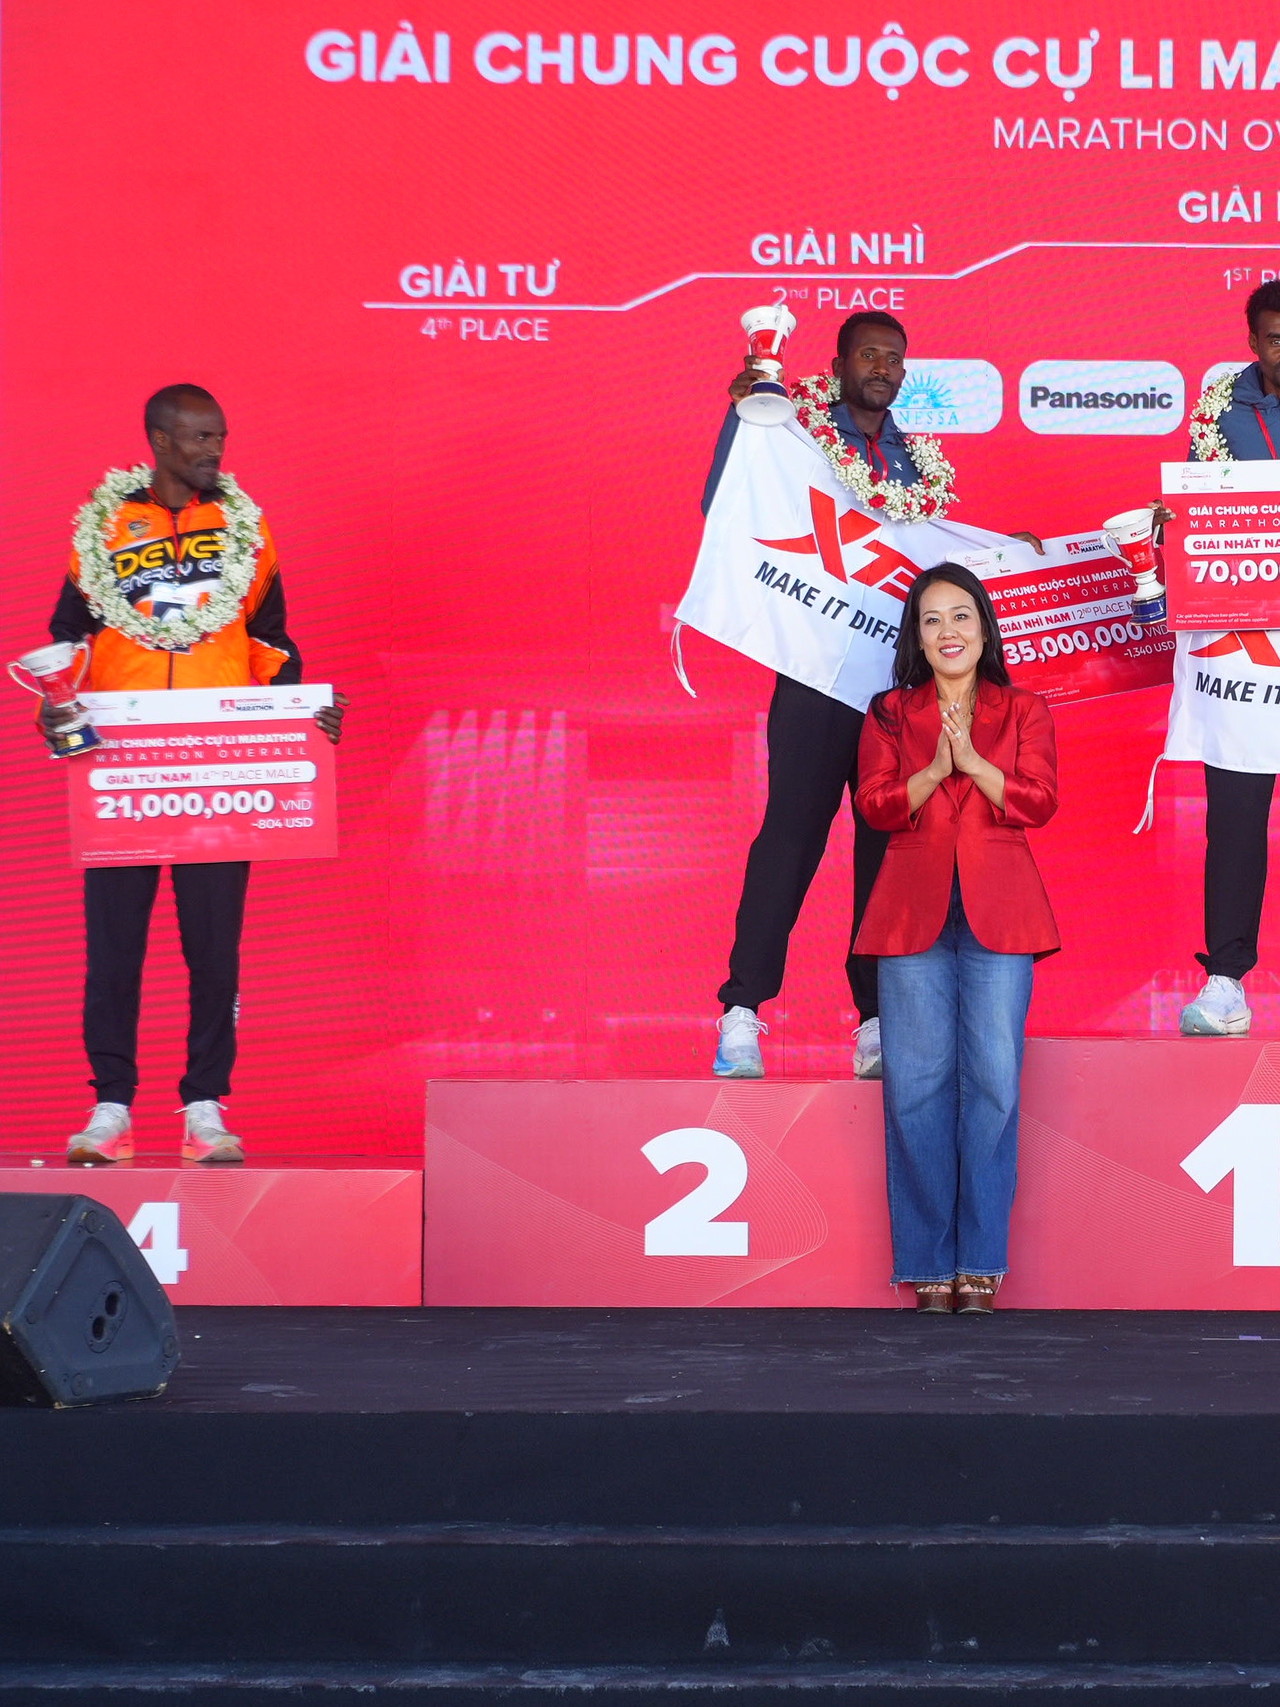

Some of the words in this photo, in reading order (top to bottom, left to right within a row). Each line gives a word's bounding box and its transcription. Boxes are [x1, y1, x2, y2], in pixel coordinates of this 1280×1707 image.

[305, 20, 451, 84] GIẢI
[473, 31, 738, 87] CHUNG
[760, 21, 971, 102] CUỘC
[991, 27, 1101, 103] CỰ
[1119, 38, 1174, 90] LI
[993, 116, 1227, 151] MARATHON
[1177, 184, 1262, 224] GIẢI
[750, 226, 836, 266] GIẢI
[850, 223, 925, 265] NHÌ
[399, 257, 487, 298] GIẢI
[497, 257, 561, 297] TƯ
[1223, 267, 1252, 291] 1ST
[773, 285, 809, 309] 2nd
[817, 286, 905, 311] PLACE
[421, 317, 452, 341] 4th
[460, 317, 550, 342] PLACE
[1030, 386, 1173, 409] Panasonic
[899, 410, 960, 426] NESSA
[1188, 504, 1213, 516] GIẢI
[1214, 505, 1259, 516] CHUNG
[1192, 538, 1220, 550] GIẢI
[1224, 536, 1261, 549] NHẤT
[754, 561, 822, 608] MAKE
[821, 595, 850, 620] IT
[1001, 583, 1038, 599] CHUNG
[1038, 579, 1066, 592] CUỘC
[1068, 574, 1081, 587] CỰ
[1082, 575, 1092, 584] LI
[1091, 567, 1130, 582] MARATH
[999, 592, 1071, 612] ARATHON
[1024, 616, 1043, 629] NHÌ
[1045, 612, 1072, 625] NAM
[1076, 607, 1092, 620] 2ND
[1093, 601, 1125, 616] PLACE
[1002, 621, 1144, 665] 35,000,000
[1144, 624, 1168, 637] VND
[1153, 640, 1176, 652] USD
[1195, 671, 1257, 703] MAKE
[121, 738, 167, 749] CHUNG
[225, 735, 236, 745] LI
[238, 732, 307, 744] MARATHON
[95, 750, 204, 763] MARATHON
[218, 747, 307, 759] OVERALL
[160, 772, 192, 783] NAM
[222, 769, 262, 781] PLACE
[265, 767, 301, 779] MALE
[96, 789, 275, 822] 21,000,000
[280, 799, 312, 811] VND
[285, 817, 313, 828] USD
[640, 1127, 749, 1257] 2
[126, 1201, 189, 1285] 4
